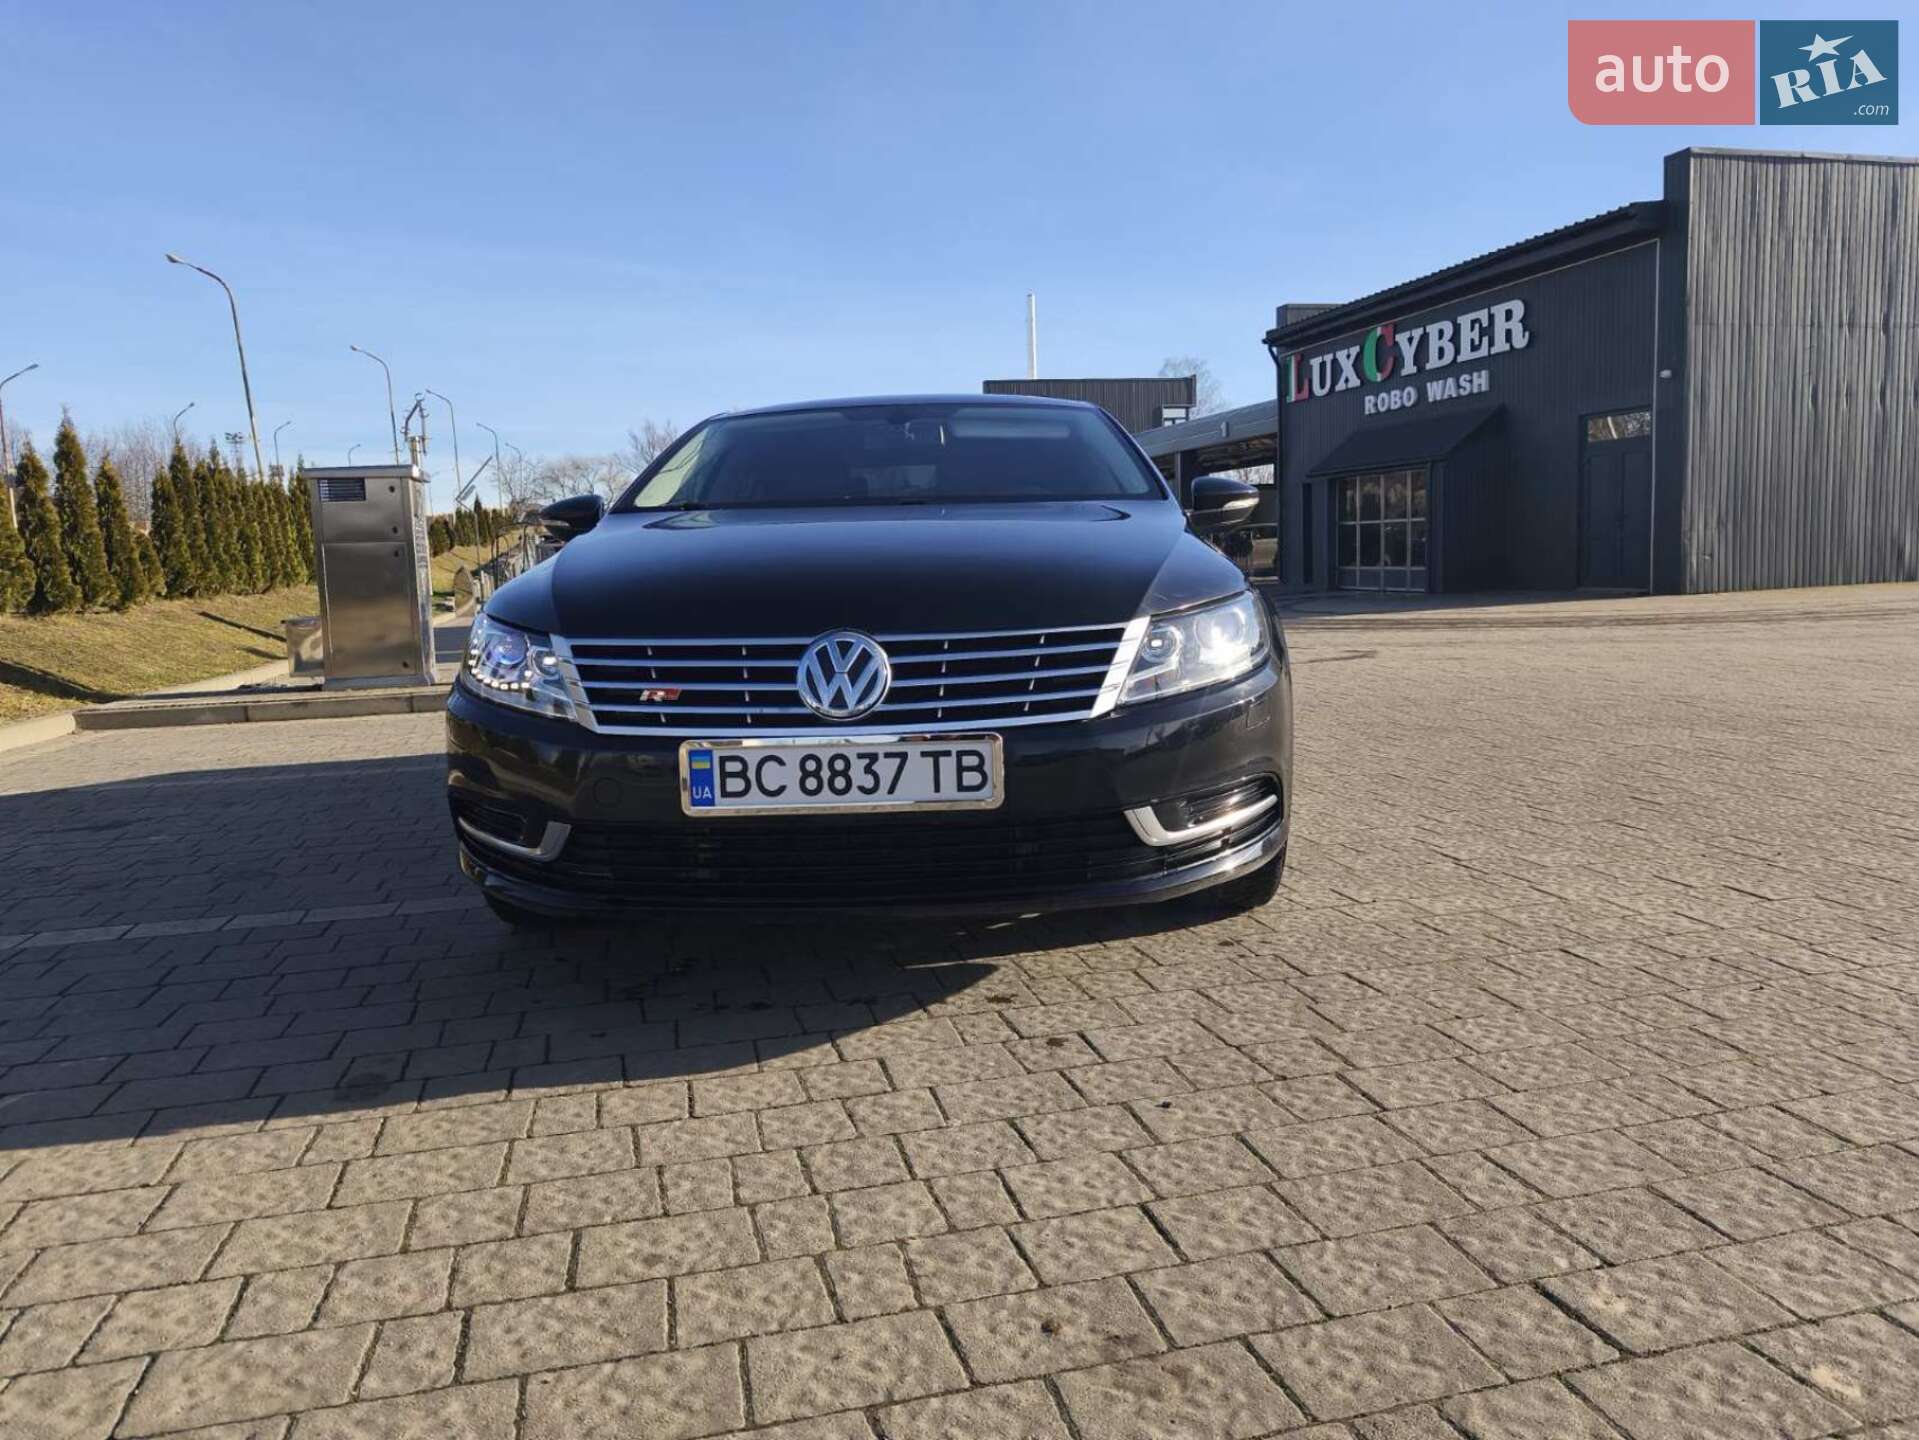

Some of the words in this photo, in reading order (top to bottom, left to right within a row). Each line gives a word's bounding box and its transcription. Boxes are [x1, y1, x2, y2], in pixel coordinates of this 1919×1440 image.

[1364, 386, 1418, 416] ROBO
[1426, 369, 1490, 403] WASH
[693, 786, 713, 800] UA
[718, 753, 788, 799] BC
[799, 751, 909, 796] 8837
[920, 749, 989, 793] TB
